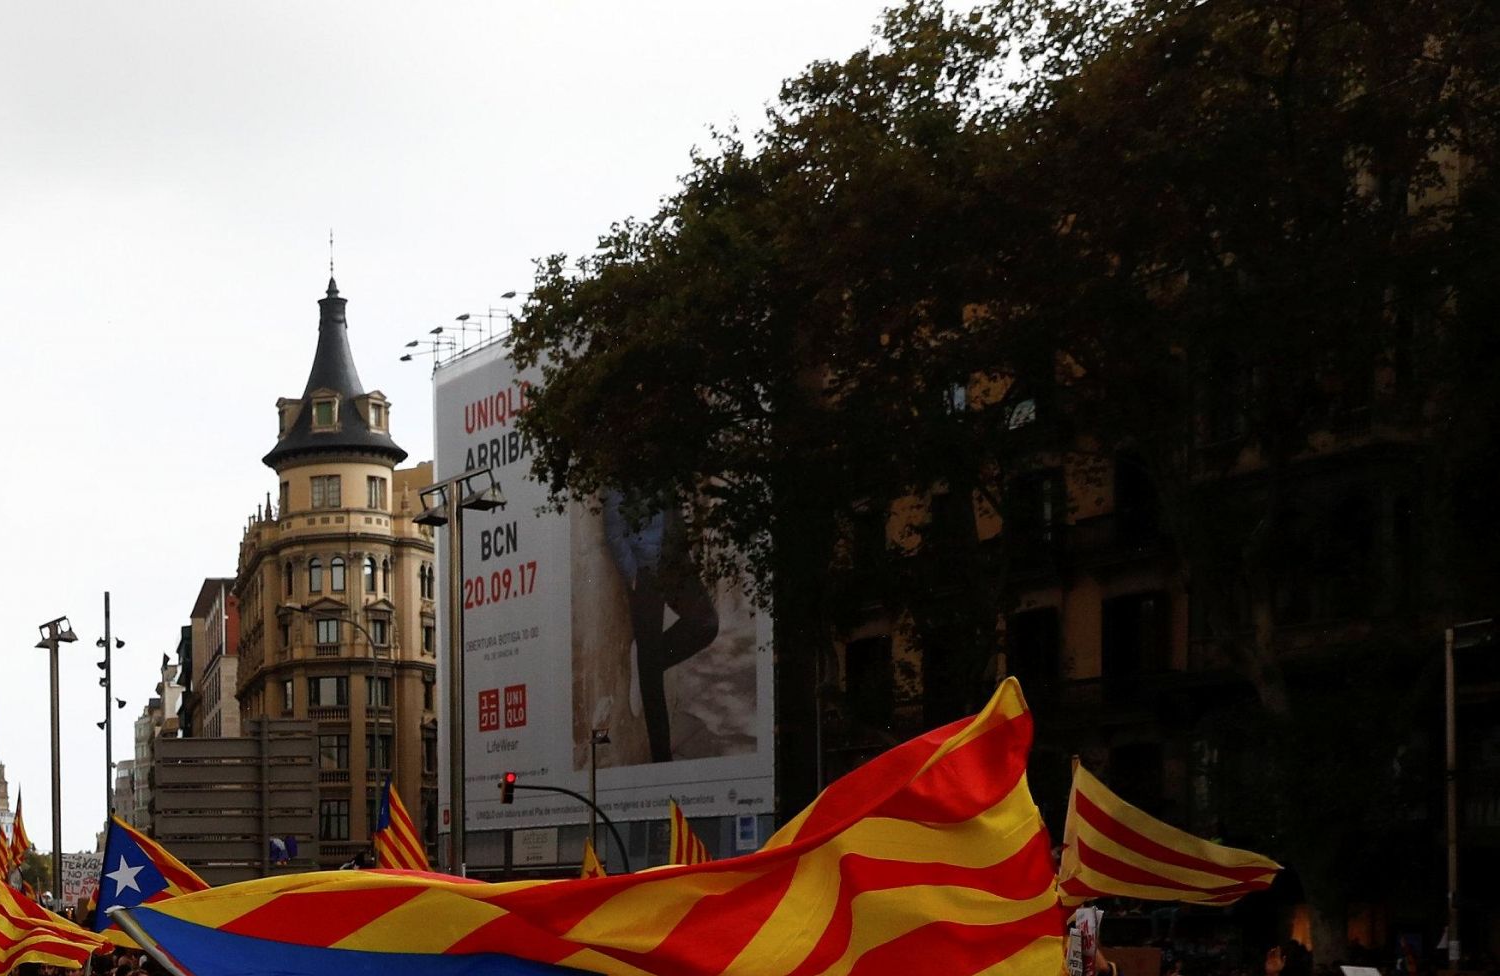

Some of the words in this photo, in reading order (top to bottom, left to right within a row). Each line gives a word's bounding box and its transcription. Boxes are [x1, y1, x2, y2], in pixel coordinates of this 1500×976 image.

[465, 432, 534, 473] ARRIBA
[481, 521, 517, 561] BCN
[464, 561, 537, 610] 20.09.17
[506, 690, 523, 705] UNI
[506, 707, 525, 725] QLO
